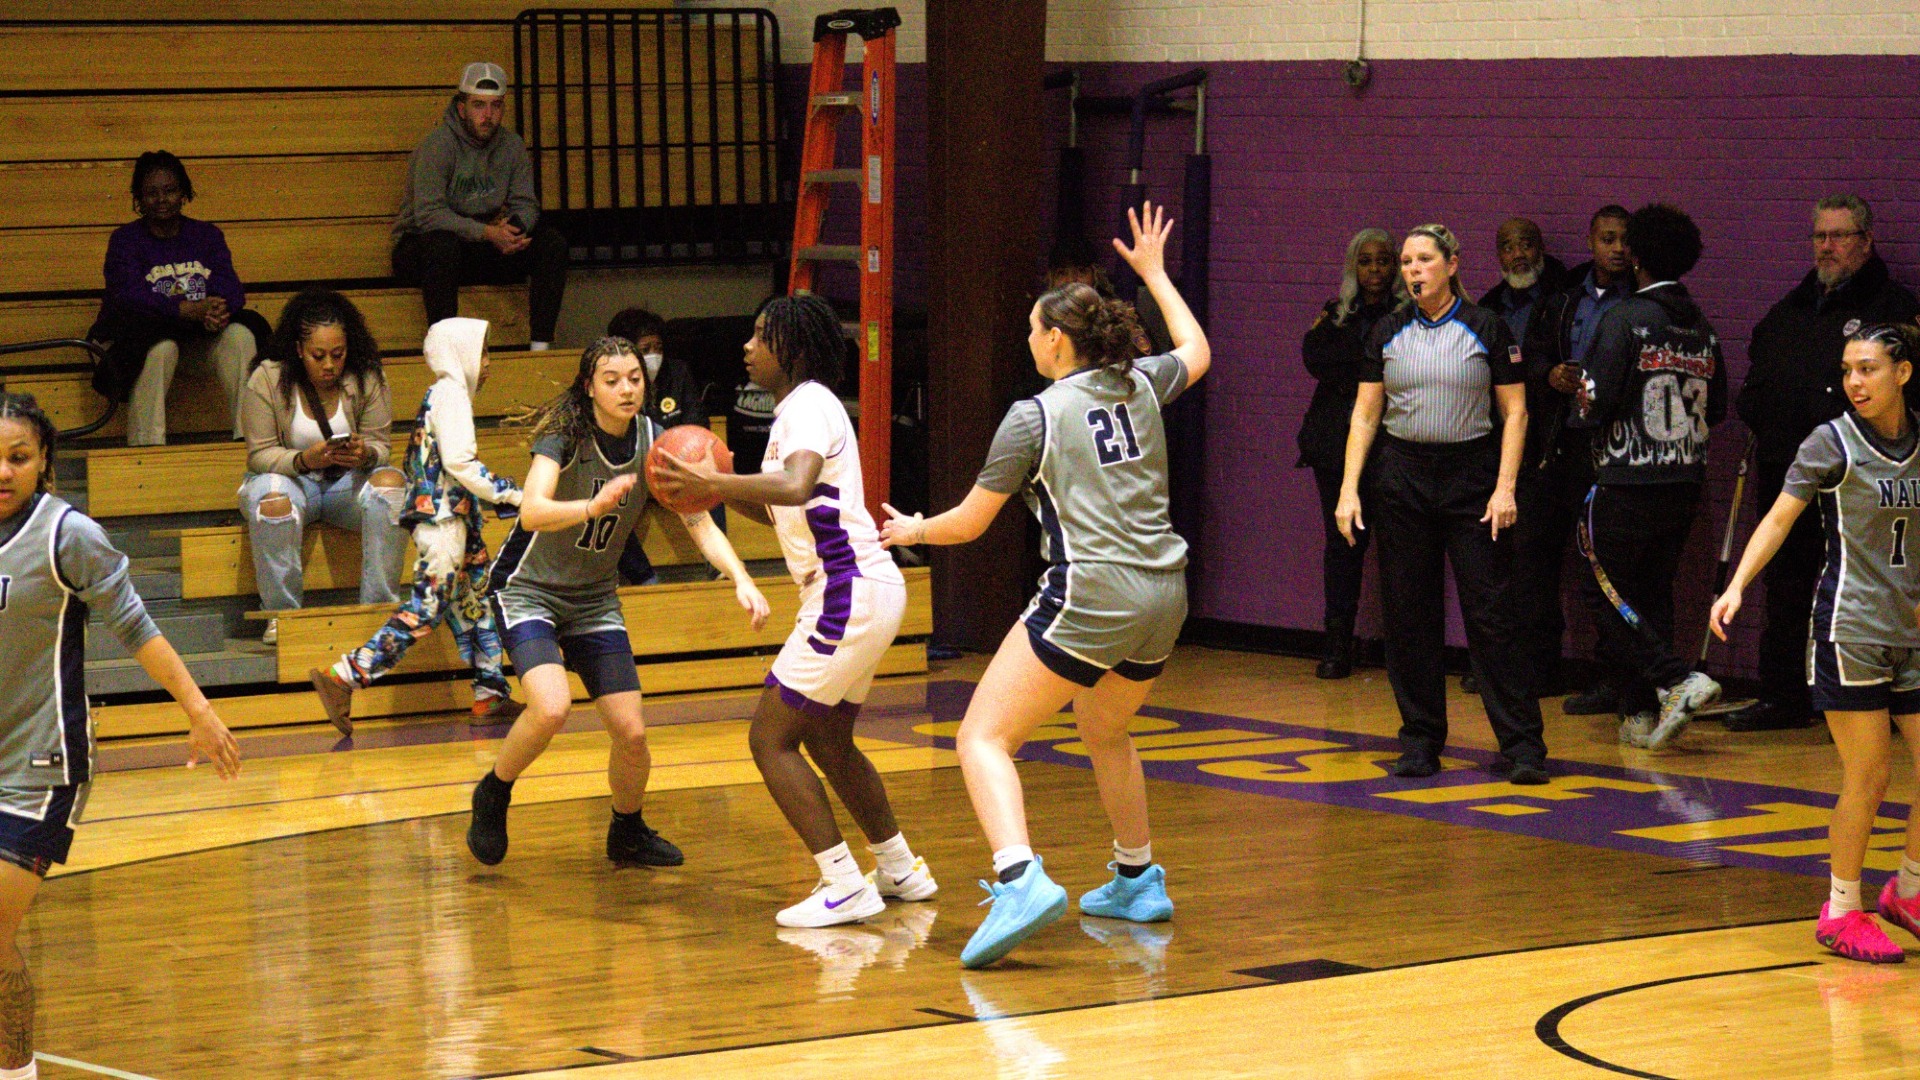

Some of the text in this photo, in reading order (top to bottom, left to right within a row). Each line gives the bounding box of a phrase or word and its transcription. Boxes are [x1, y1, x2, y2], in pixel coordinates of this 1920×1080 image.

[1086, 402, 1143, 466] 21
[1643, 374, 1709, 442] 03
[575, 514, 620, 553] 10
[1890, 517, 1908, 567] 1
